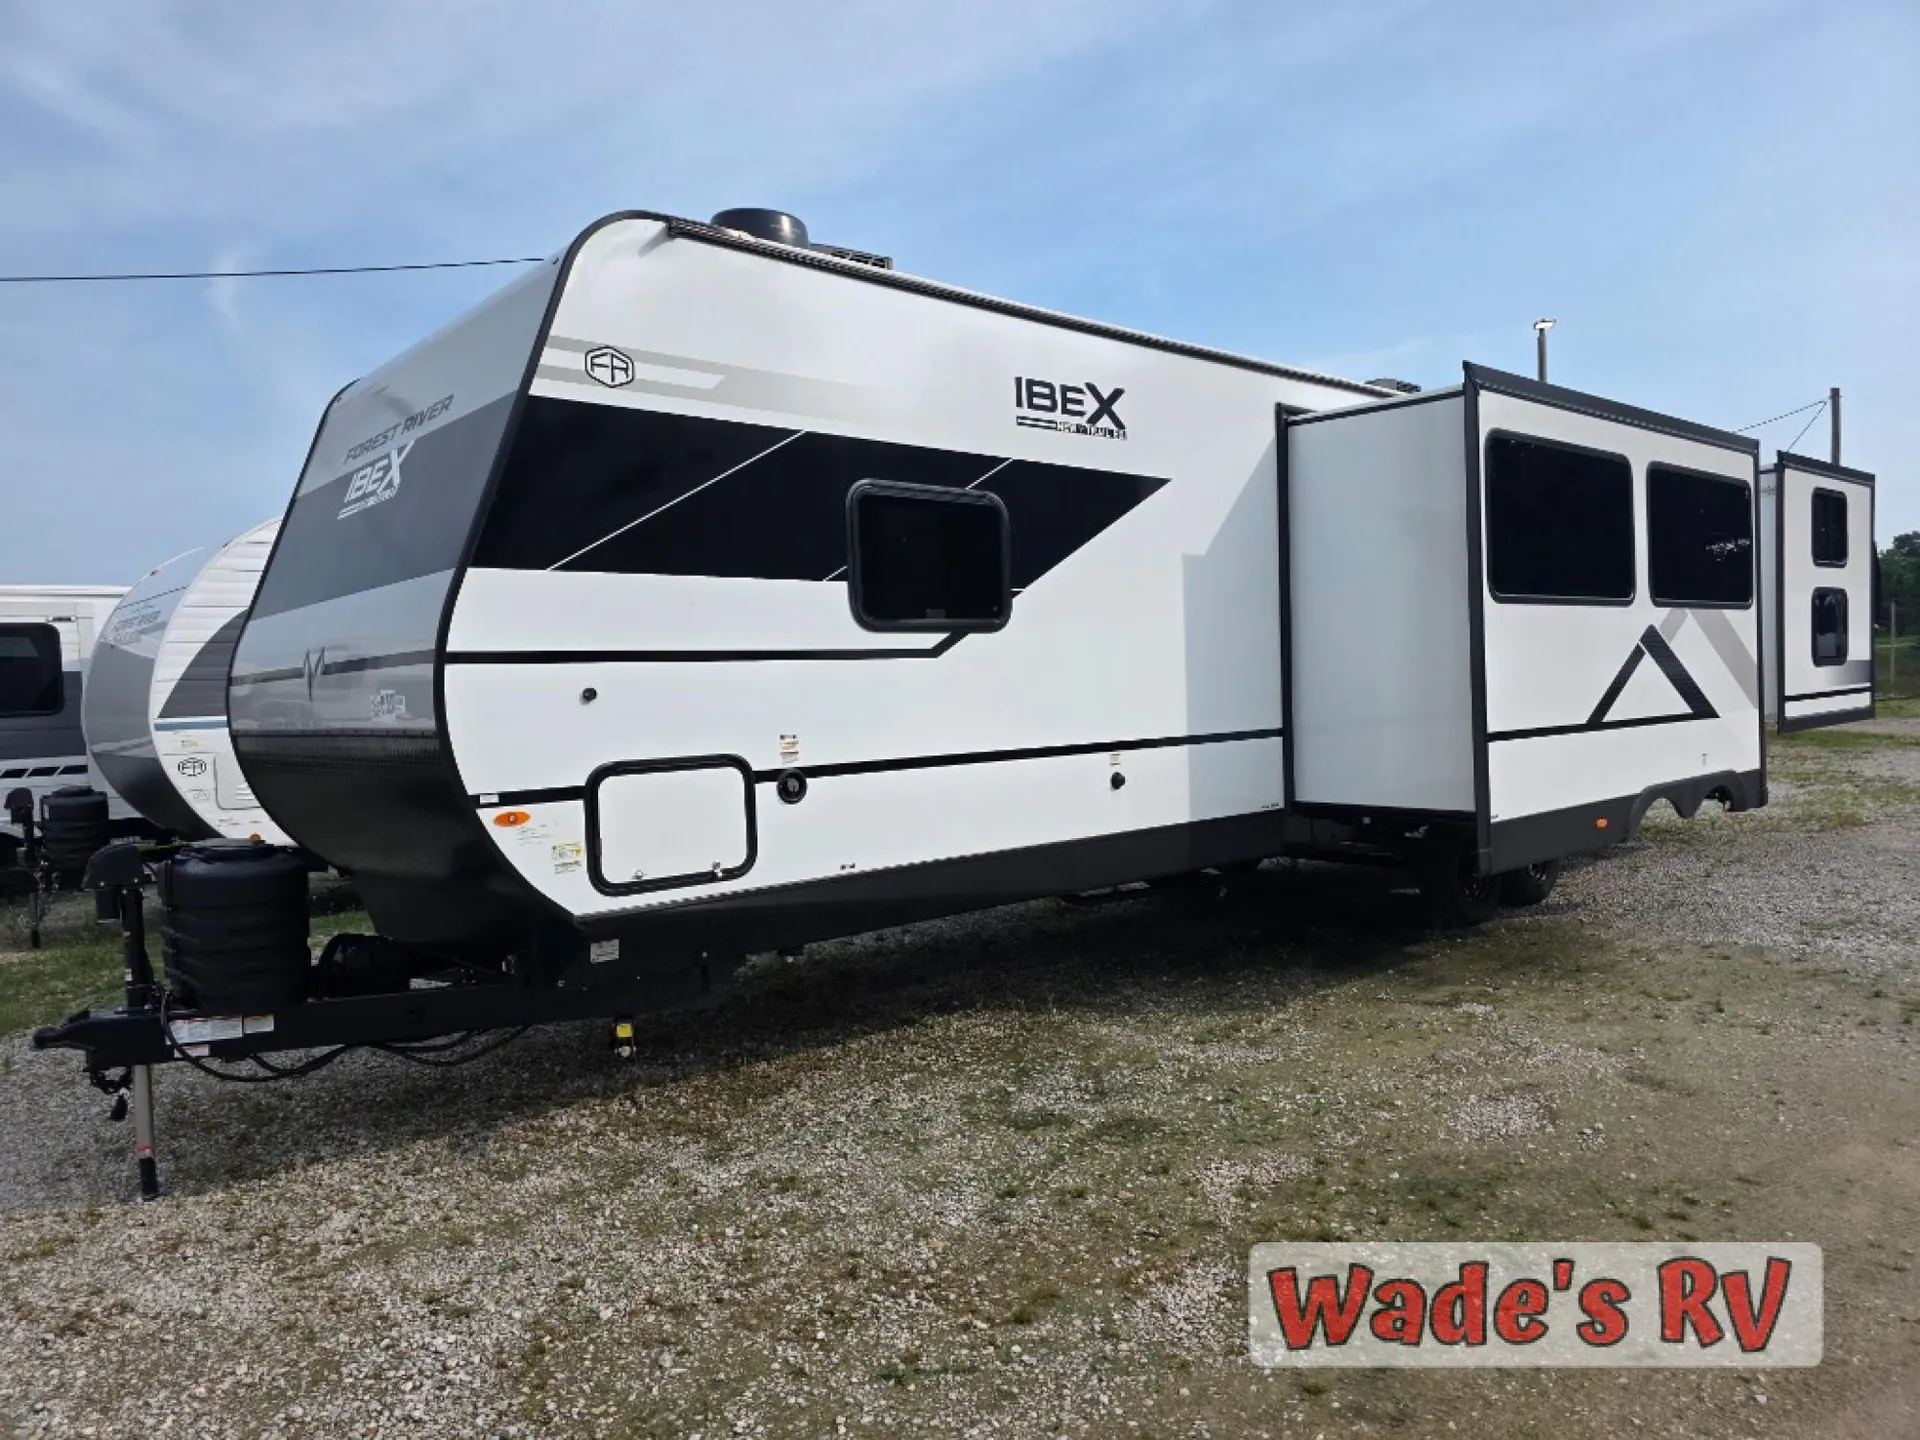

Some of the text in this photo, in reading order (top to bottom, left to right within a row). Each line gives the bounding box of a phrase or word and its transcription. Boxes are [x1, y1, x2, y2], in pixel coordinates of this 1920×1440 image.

[343, 393, 455, 465] FOREST RIVER
[1014, 376, 1125, 430] IBEX
[343, 439, 417, 503] IBEX
